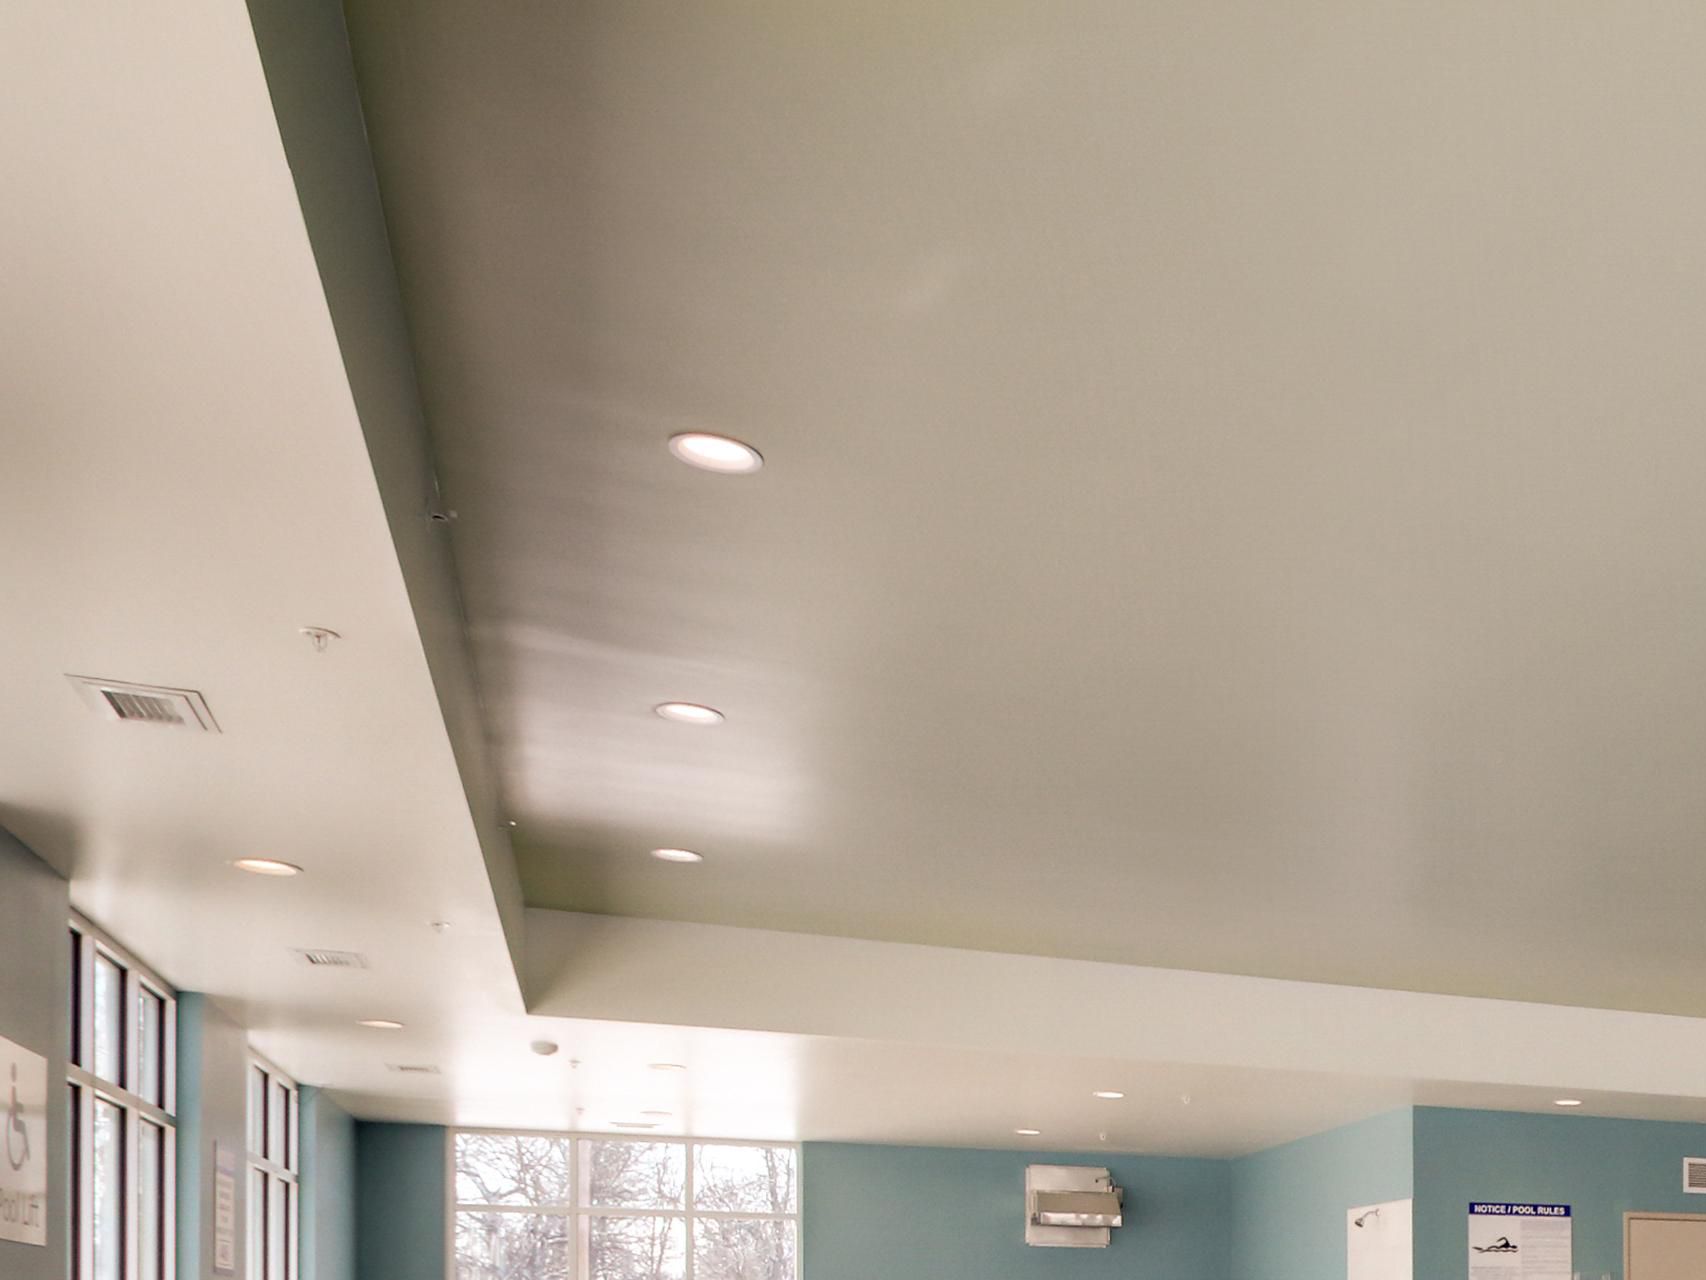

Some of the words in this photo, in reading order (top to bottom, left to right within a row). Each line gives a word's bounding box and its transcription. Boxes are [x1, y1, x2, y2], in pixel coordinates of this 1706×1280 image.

[1474, 1205, 1506, 1213] NOTICE
[1512, 1206, 1536, 1214] POOL
[1537, 1207, 1565, 1215] RULES
